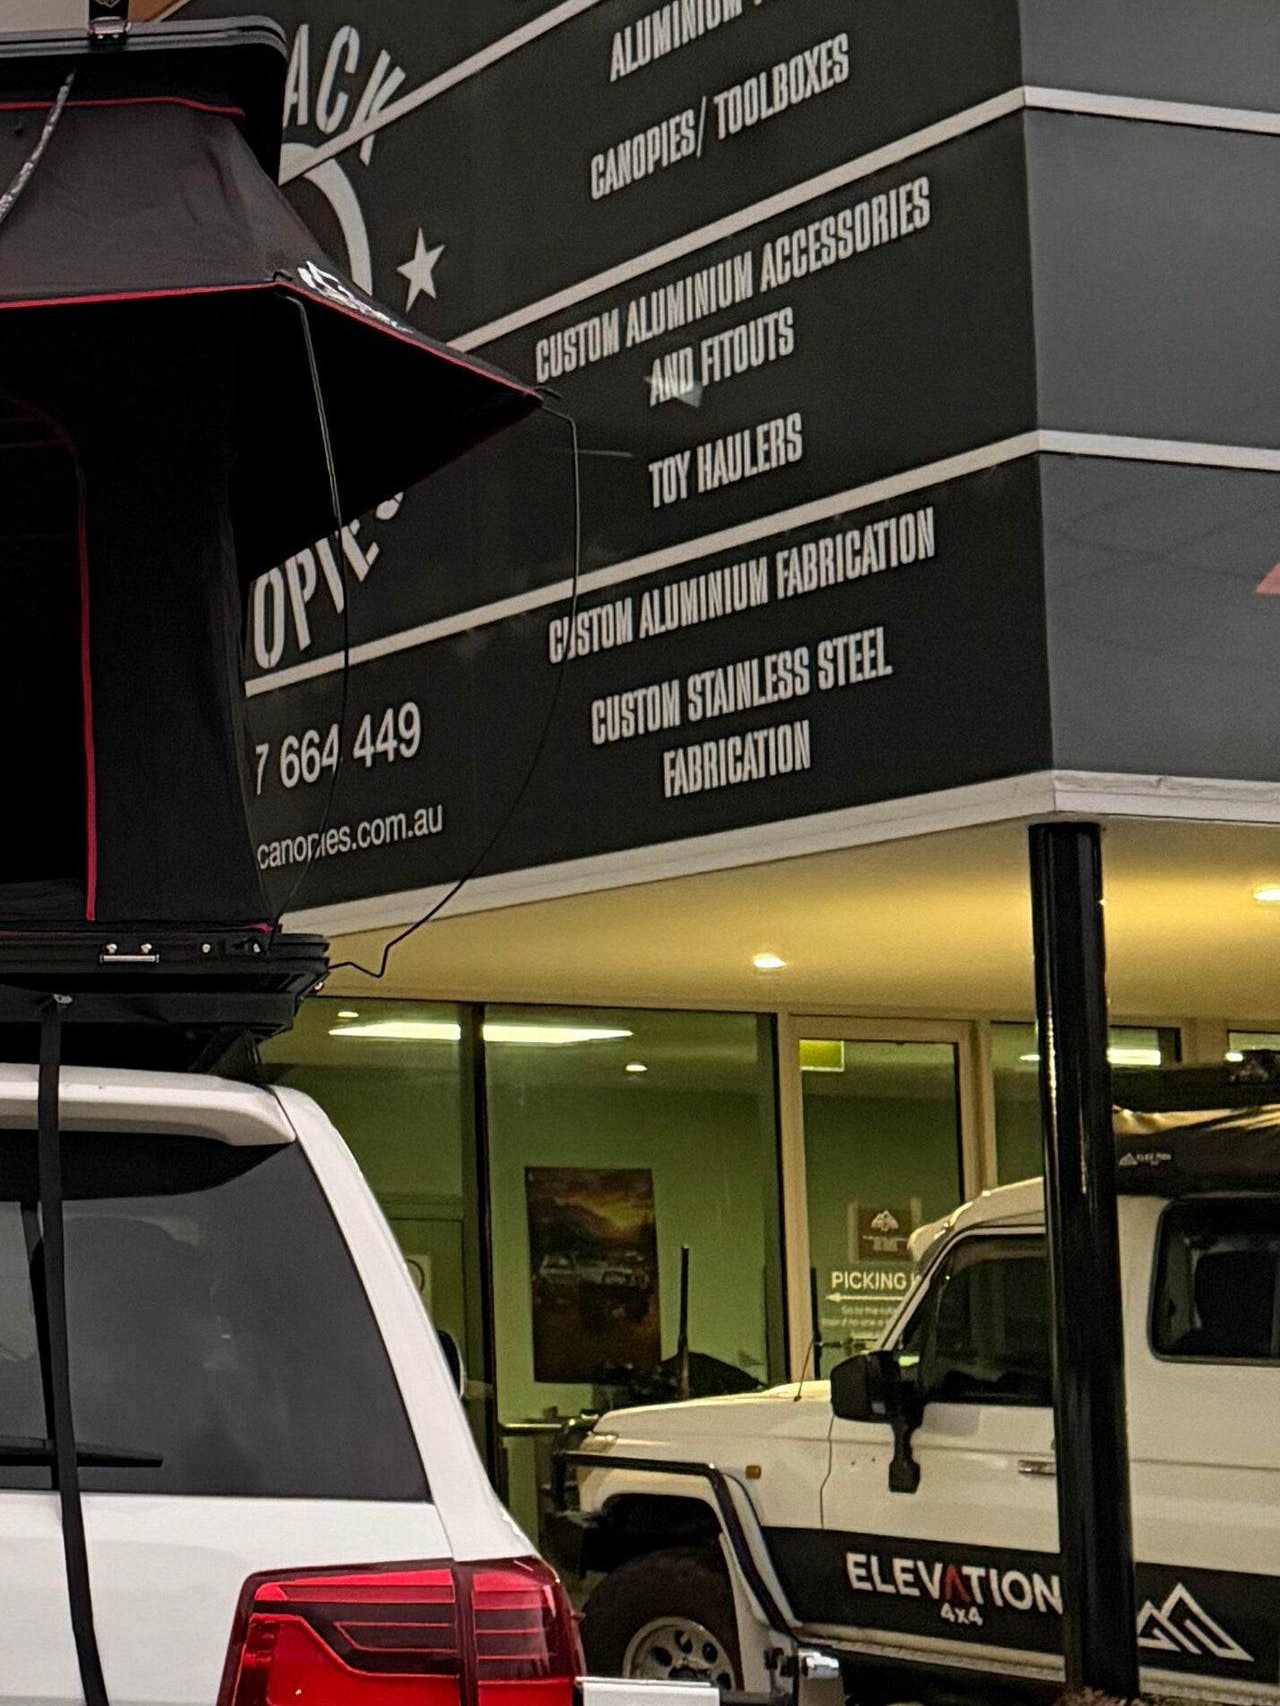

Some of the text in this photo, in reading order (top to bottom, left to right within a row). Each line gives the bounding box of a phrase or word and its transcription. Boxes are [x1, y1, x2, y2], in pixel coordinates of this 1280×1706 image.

[591, 33, 848, 199] CANOPIES/ TOOLBOXES
[535, 177, 930, 382] CUSTOM ALUMINIUM ACCESSORIES
[649, 307, 794, 407] AND FITOUTS
[649, 412, 802, 508] TOY HAULERS
[549, 507, 935, 664] CUSTOM ALUMINIUM FABRICATION
[591, 626, 893, 745] CUSTOM STAINLESS STEEL
[280, 723, 343, 788] 664
[353, 702, 421, 768] 449
[663, 720, 810, 798] FABRICATION
[257, 804, 443, 870] canopies.com.au
[831, 1271, 907, 1290] PICKING
[846, 1552, 1063, 1615] ELEVATION
[941, 1602, 983, 1626] 4x4
